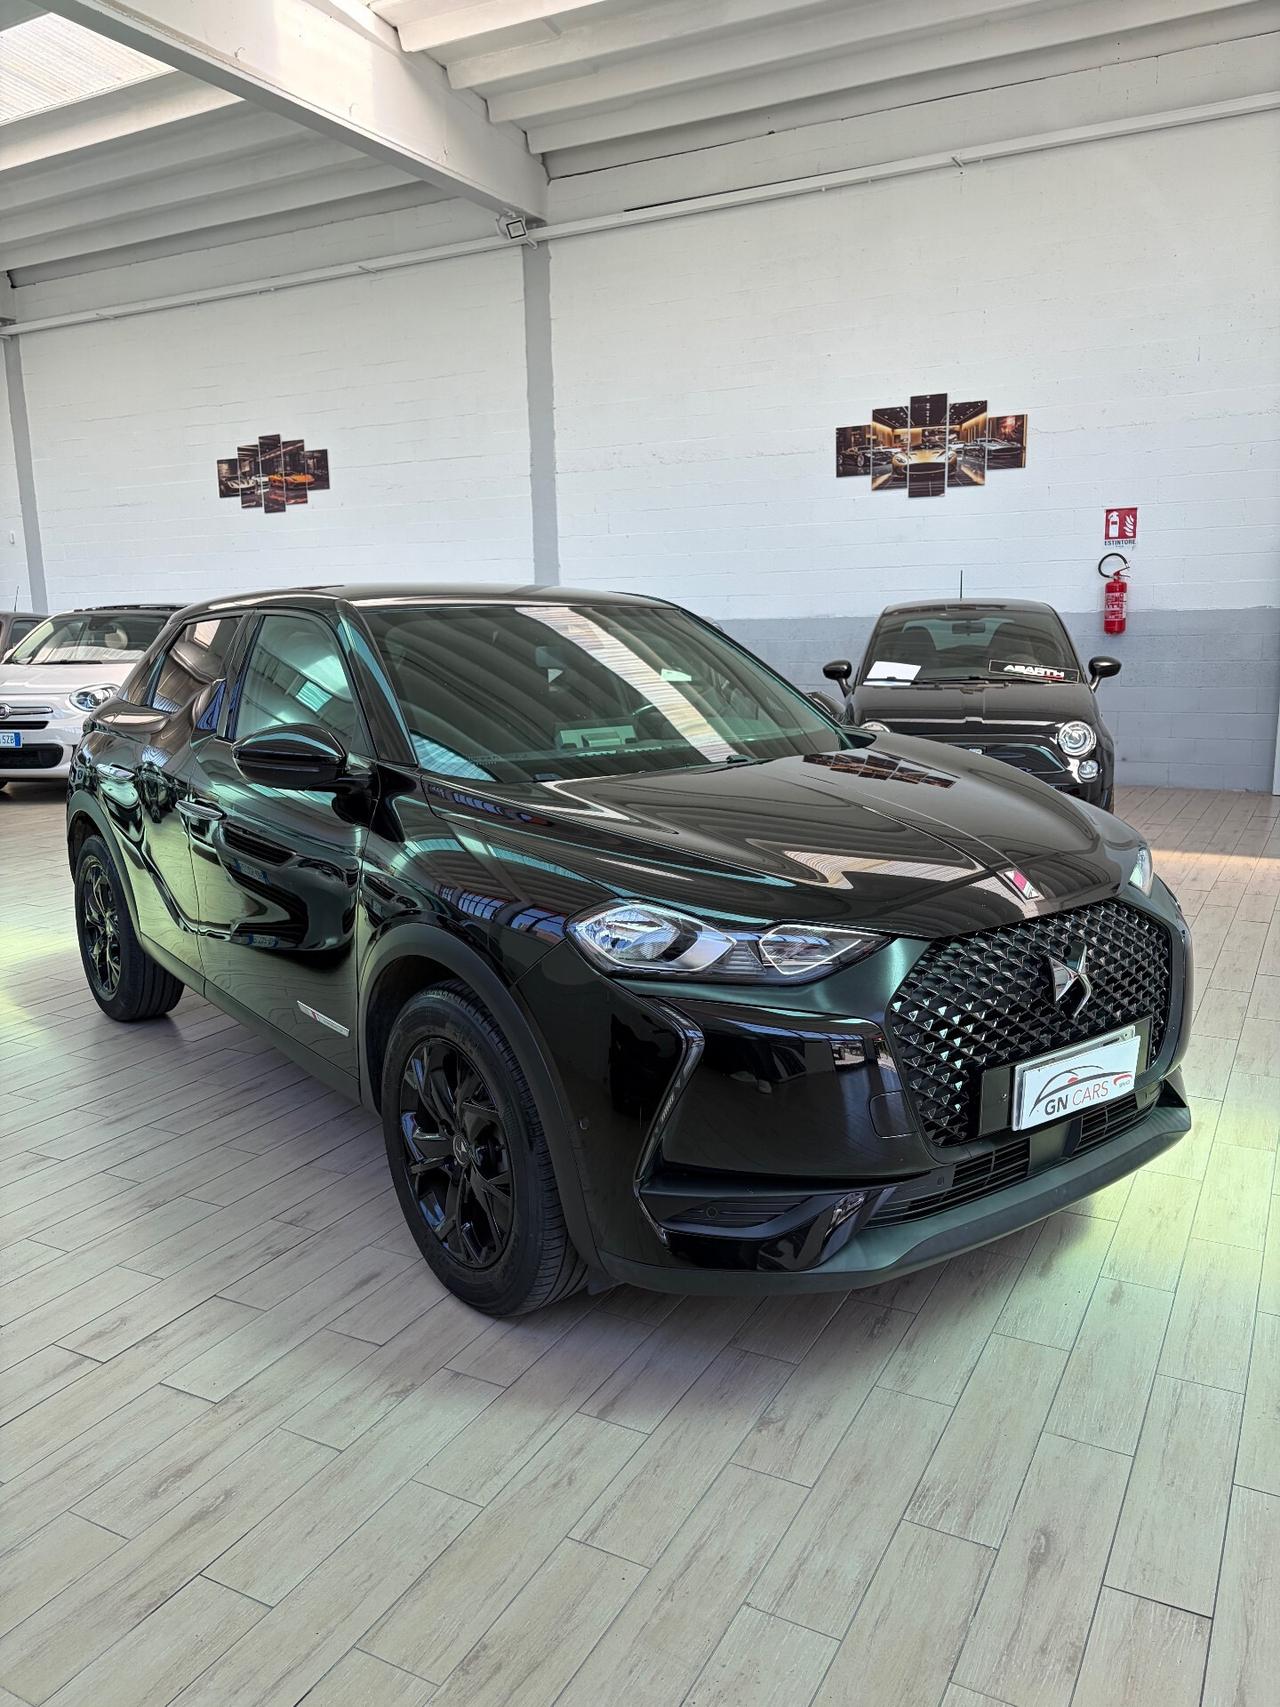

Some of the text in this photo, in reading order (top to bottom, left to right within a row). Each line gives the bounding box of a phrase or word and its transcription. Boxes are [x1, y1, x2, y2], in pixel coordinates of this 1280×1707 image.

[1003, 664, 1064, 678] ABARTH
[1044, 1080, 1109, 1115] GN CARS
